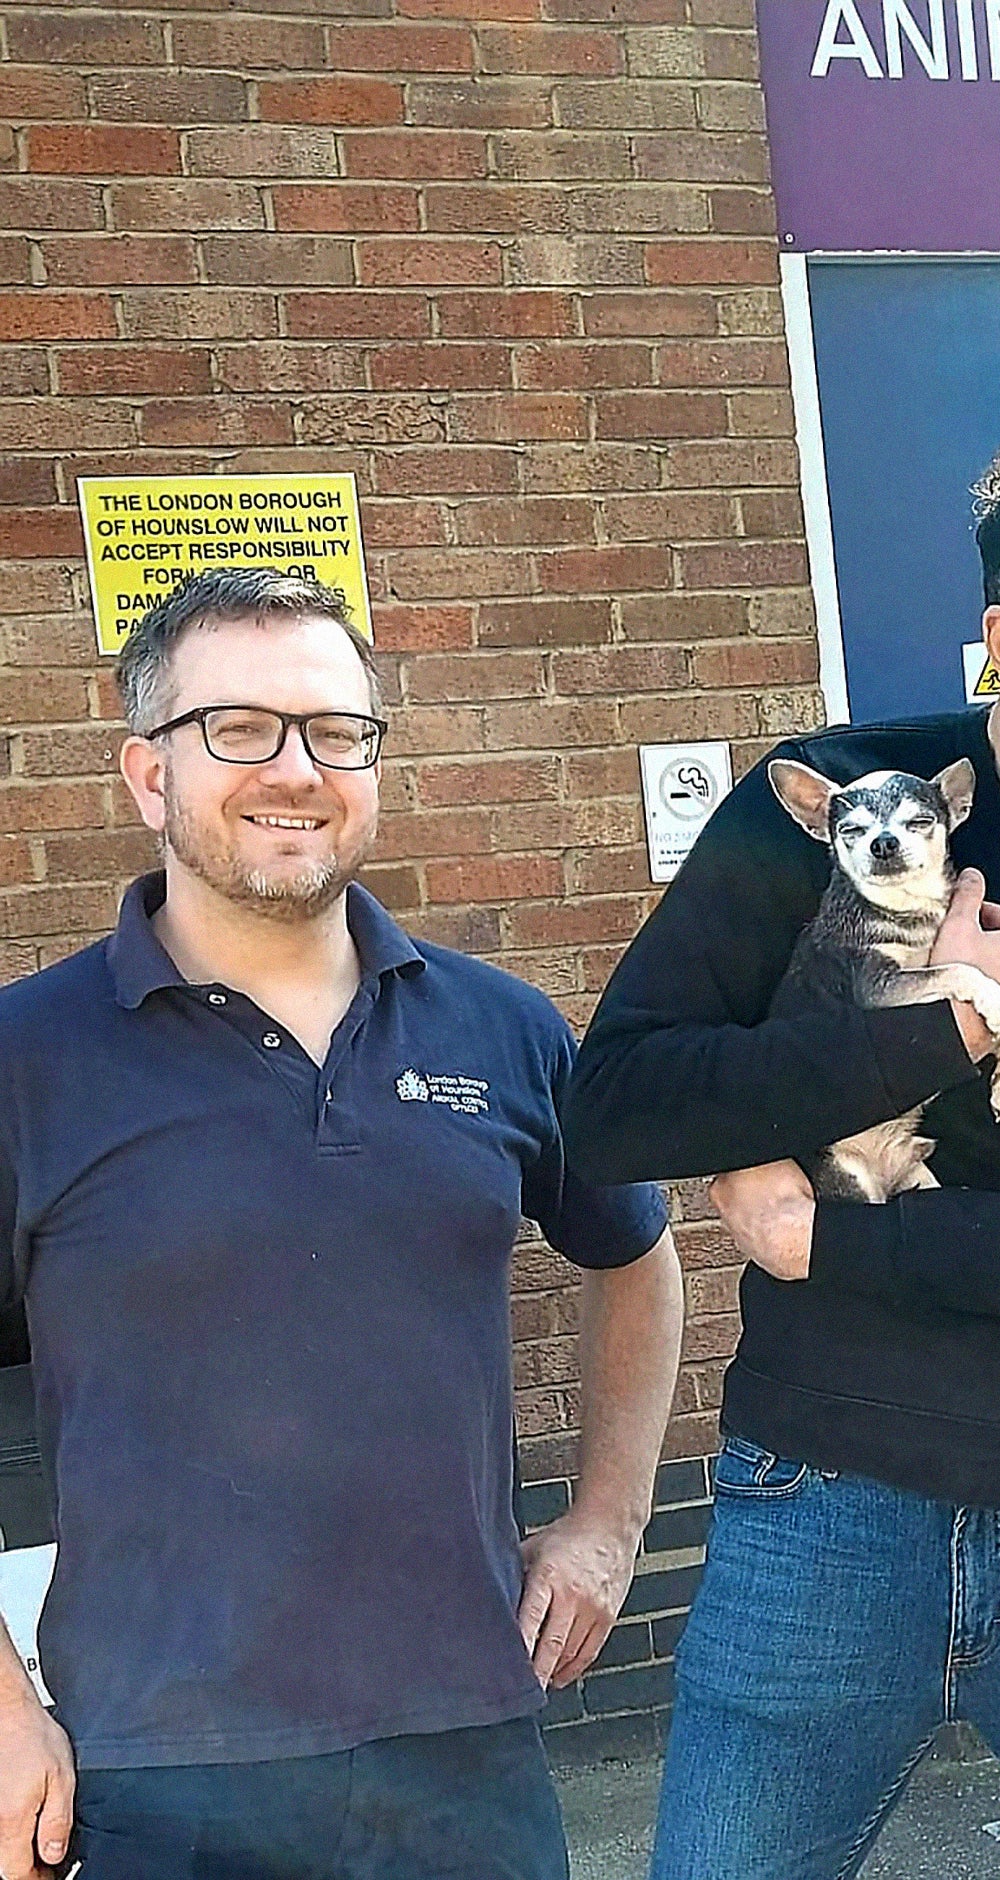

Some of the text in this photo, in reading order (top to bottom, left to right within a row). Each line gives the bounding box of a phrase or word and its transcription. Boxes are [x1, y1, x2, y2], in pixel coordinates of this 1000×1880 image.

[98, 492, 341, 511] THE LONDON BOROUGH
[97, 516, 348, 537] OF HOUNSLOW WILL NOT
[101, 540, 350, 562] ACCEPT RESPONSIBILITY
[143, 566, 185, 585] FOR
[116, 593, 171, 610] DAM
